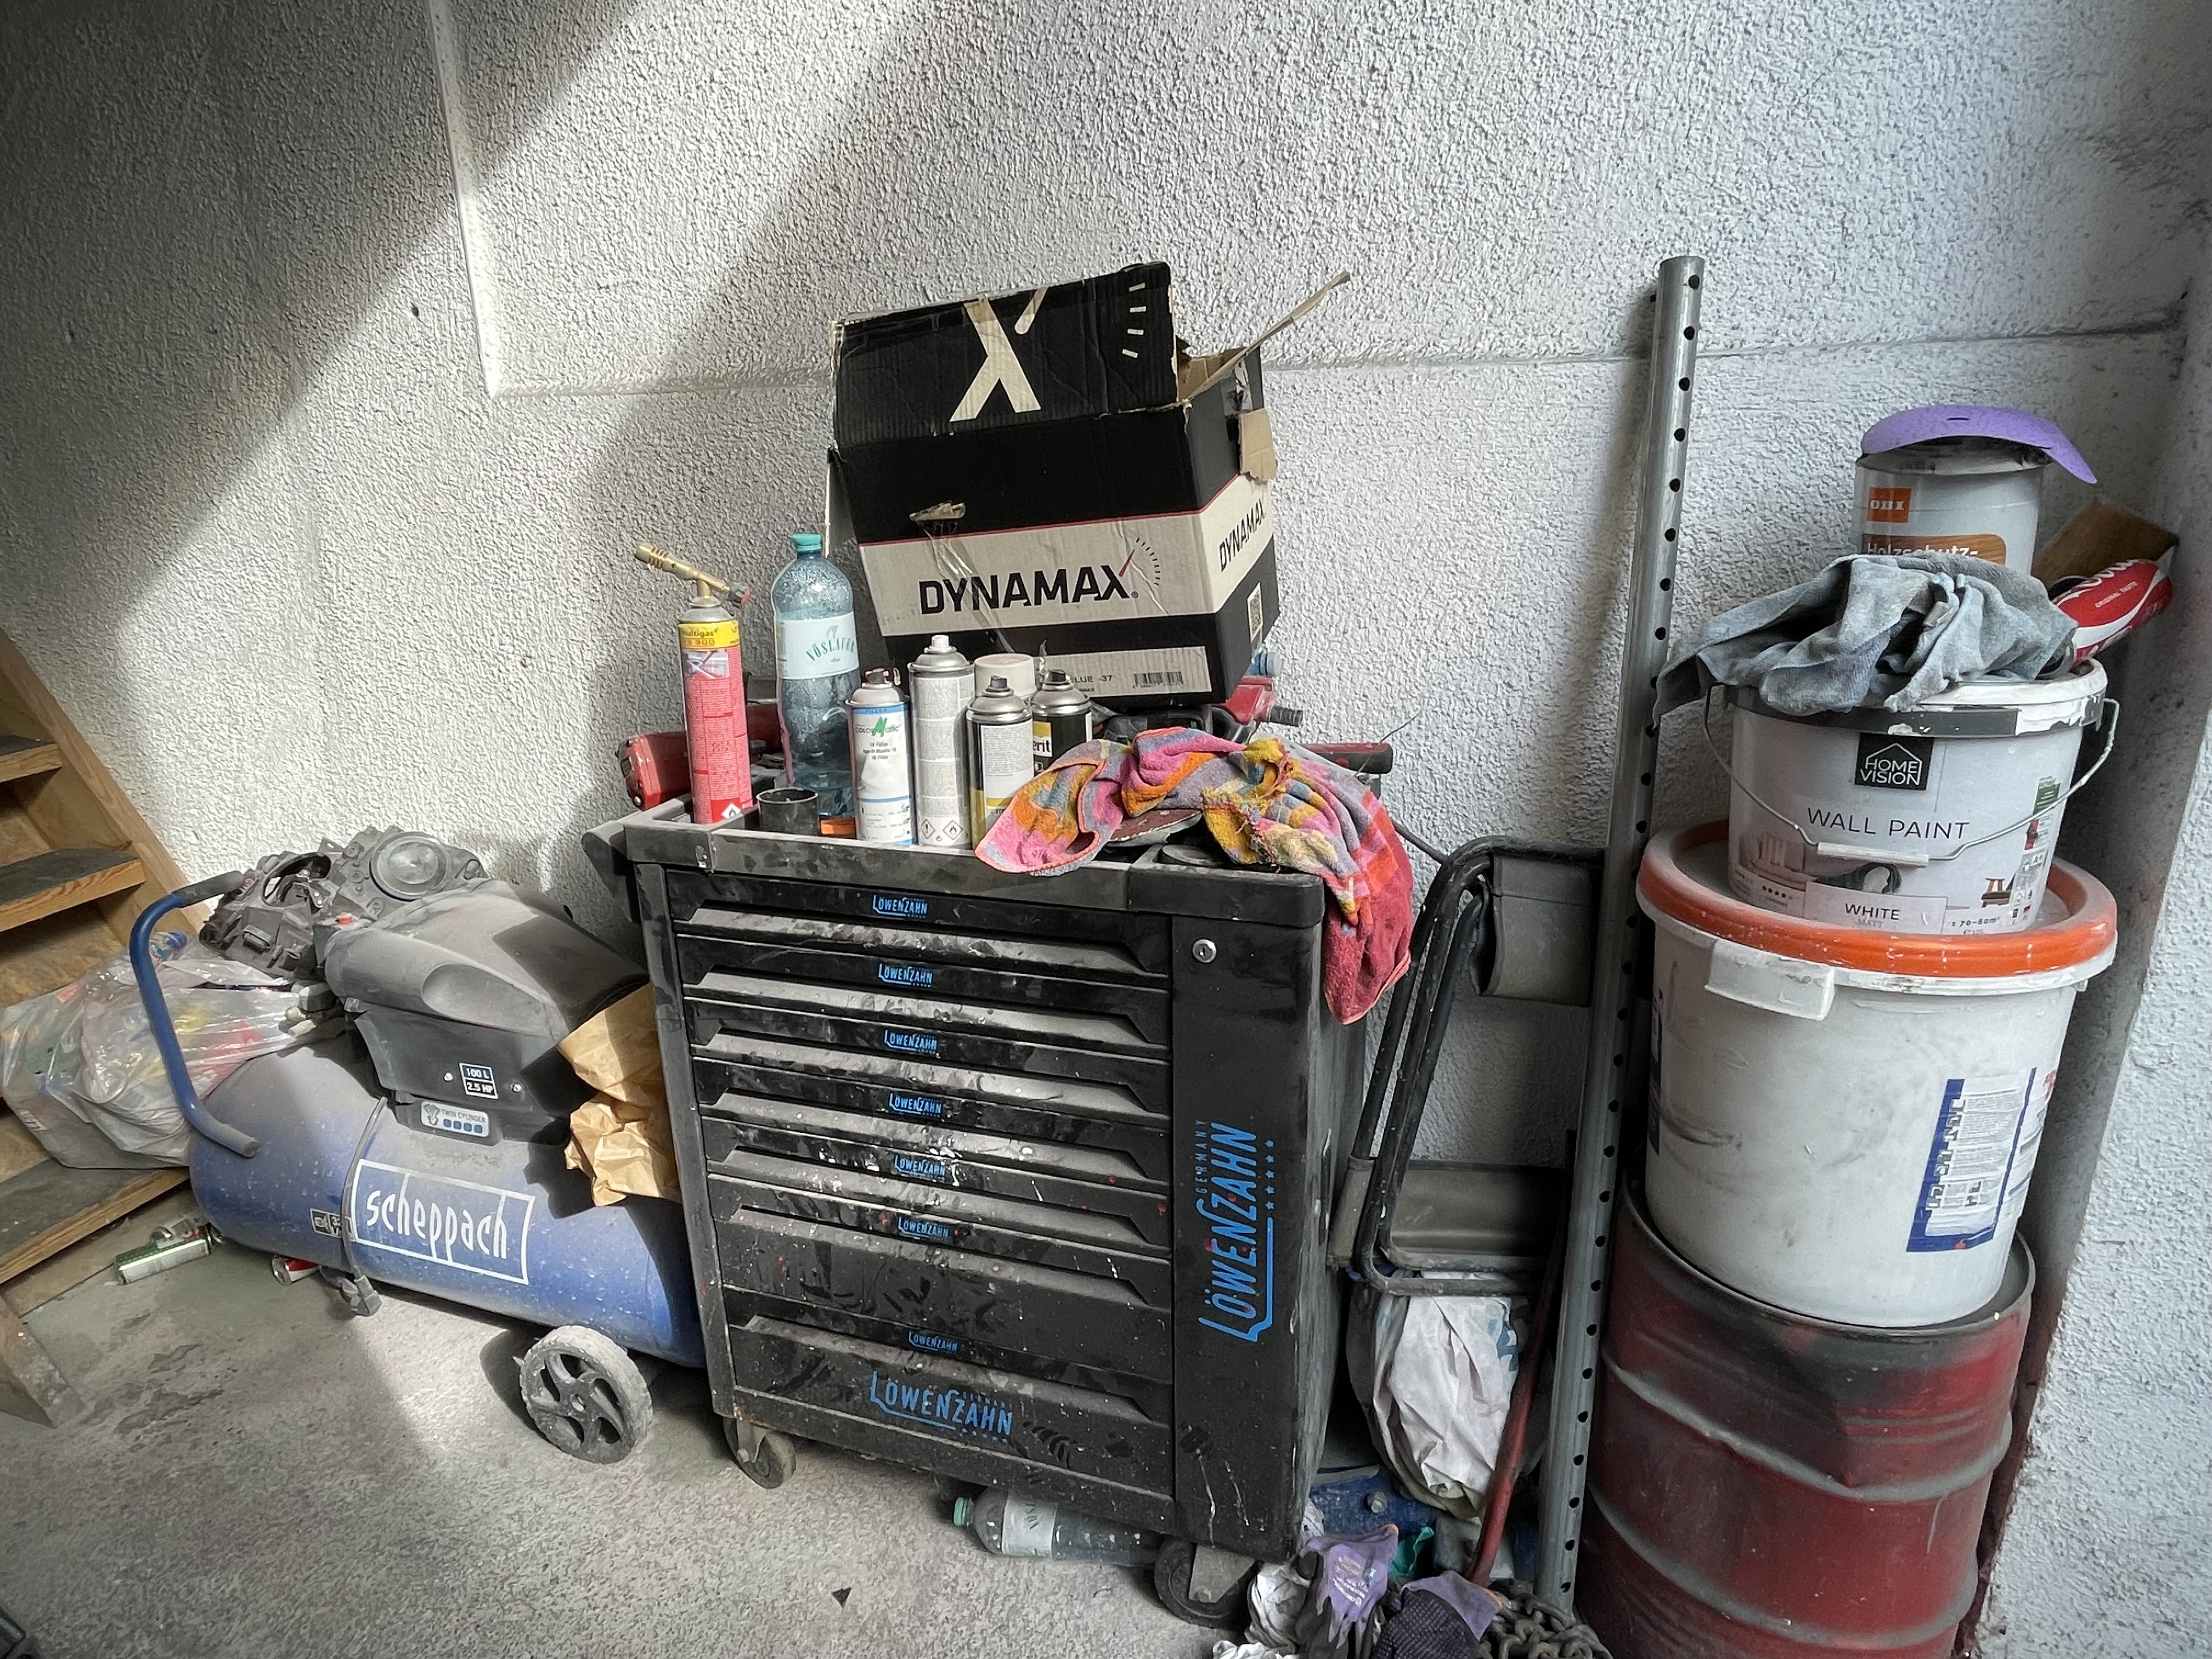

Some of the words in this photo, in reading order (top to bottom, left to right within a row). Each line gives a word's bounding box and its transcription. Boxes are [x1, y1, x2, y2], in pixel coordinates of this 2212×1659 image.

[1870, 499, 1905, 511] OBI
[1219, 497, 1266, 572] DYNAMAX
[918, 565, 1130, 615] DYNAMAX
[806, 637, 855, 662] VÖSLAUER
[1071, 675, 1093, 684] LUE
[1860, 767, 1922, 786] VISION
[1865, 757, 1920, 774] HOME
[1807, 807, 1876, 835] WALL
[1888, 819, 1970, 839] PAINT
[872, 894, 928, 916] LÖWENZAHN
[1845, 902, 1900, 921] WHITE
[878, 962, 933, 985] LÖWENZAHN
[466, 1068, 482, 1077] 100
[483, 1070, 489, 1079] L
[466, 1082, 481, 1092] 2.5
[482, 1084, 493, 1093] HP
[1195, 1119, 1207, 1194] GERMANY
[366, 1171, 507, 1262] scheppach
[1197, 1121, 1274, 1342] LÖWENZAHN
[870, 1370, 1013, 1435] LÖWENZAHN
